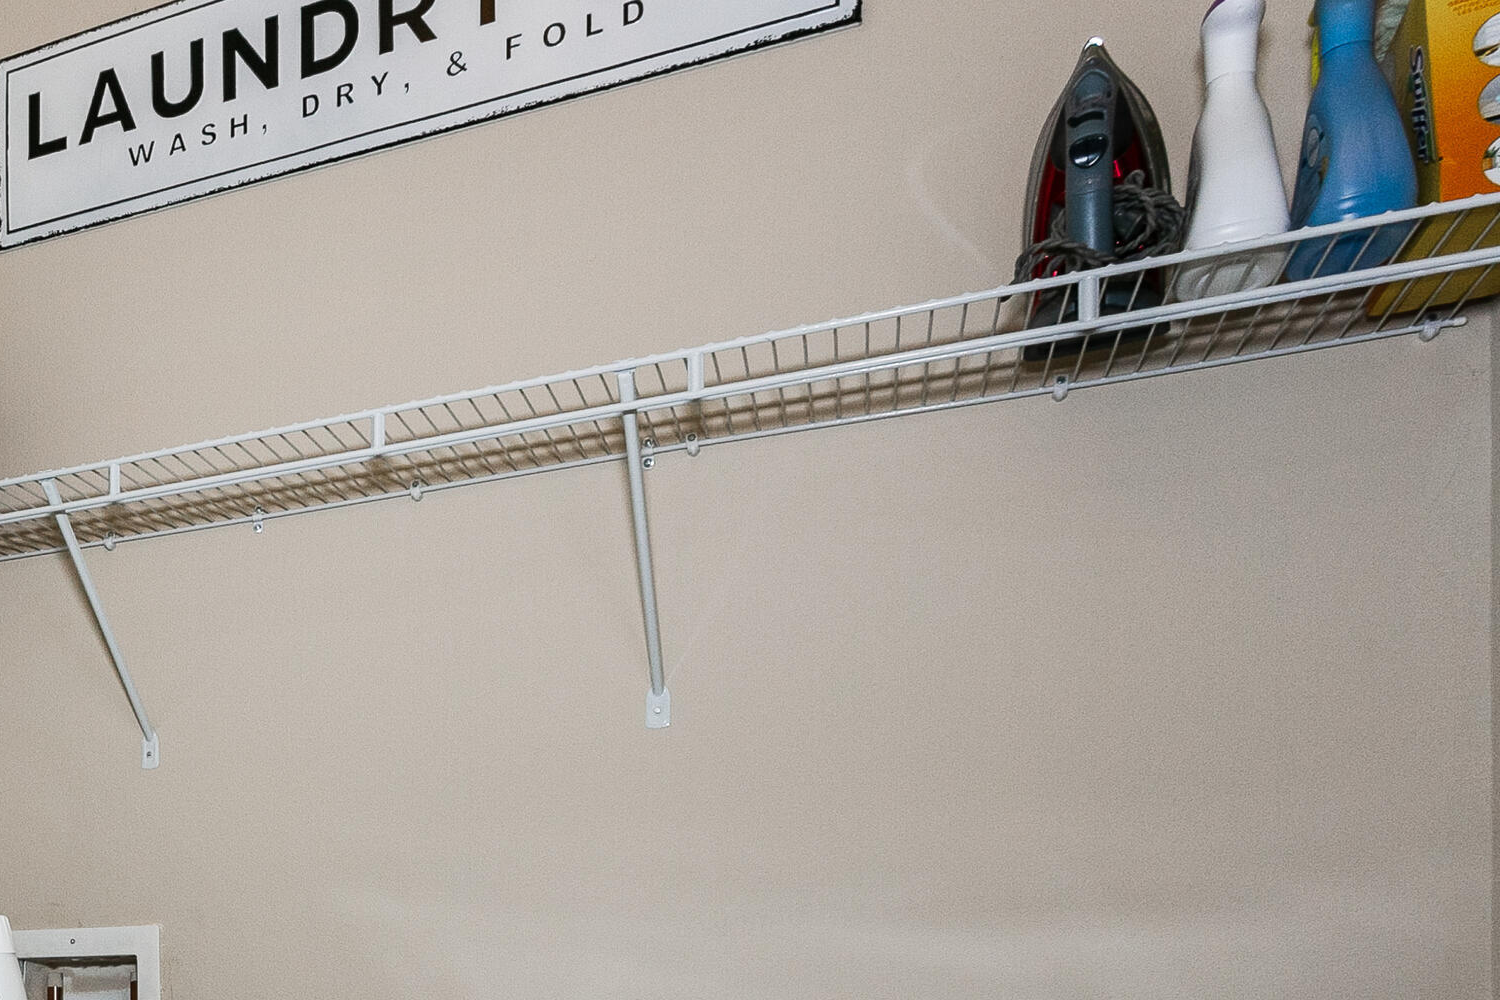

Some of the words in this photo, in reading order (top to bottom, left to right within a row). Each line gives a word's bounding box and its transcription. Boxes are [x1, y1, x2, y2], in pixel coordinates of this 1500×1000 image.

[129, 114, 269, 167] WASH,
[302, 71, 411, 119] DRY,
[446, 51, 468, 76] &
[505, 0, 644, 60] FOLD
[1410, 45, 1429, 163] Swiffer
